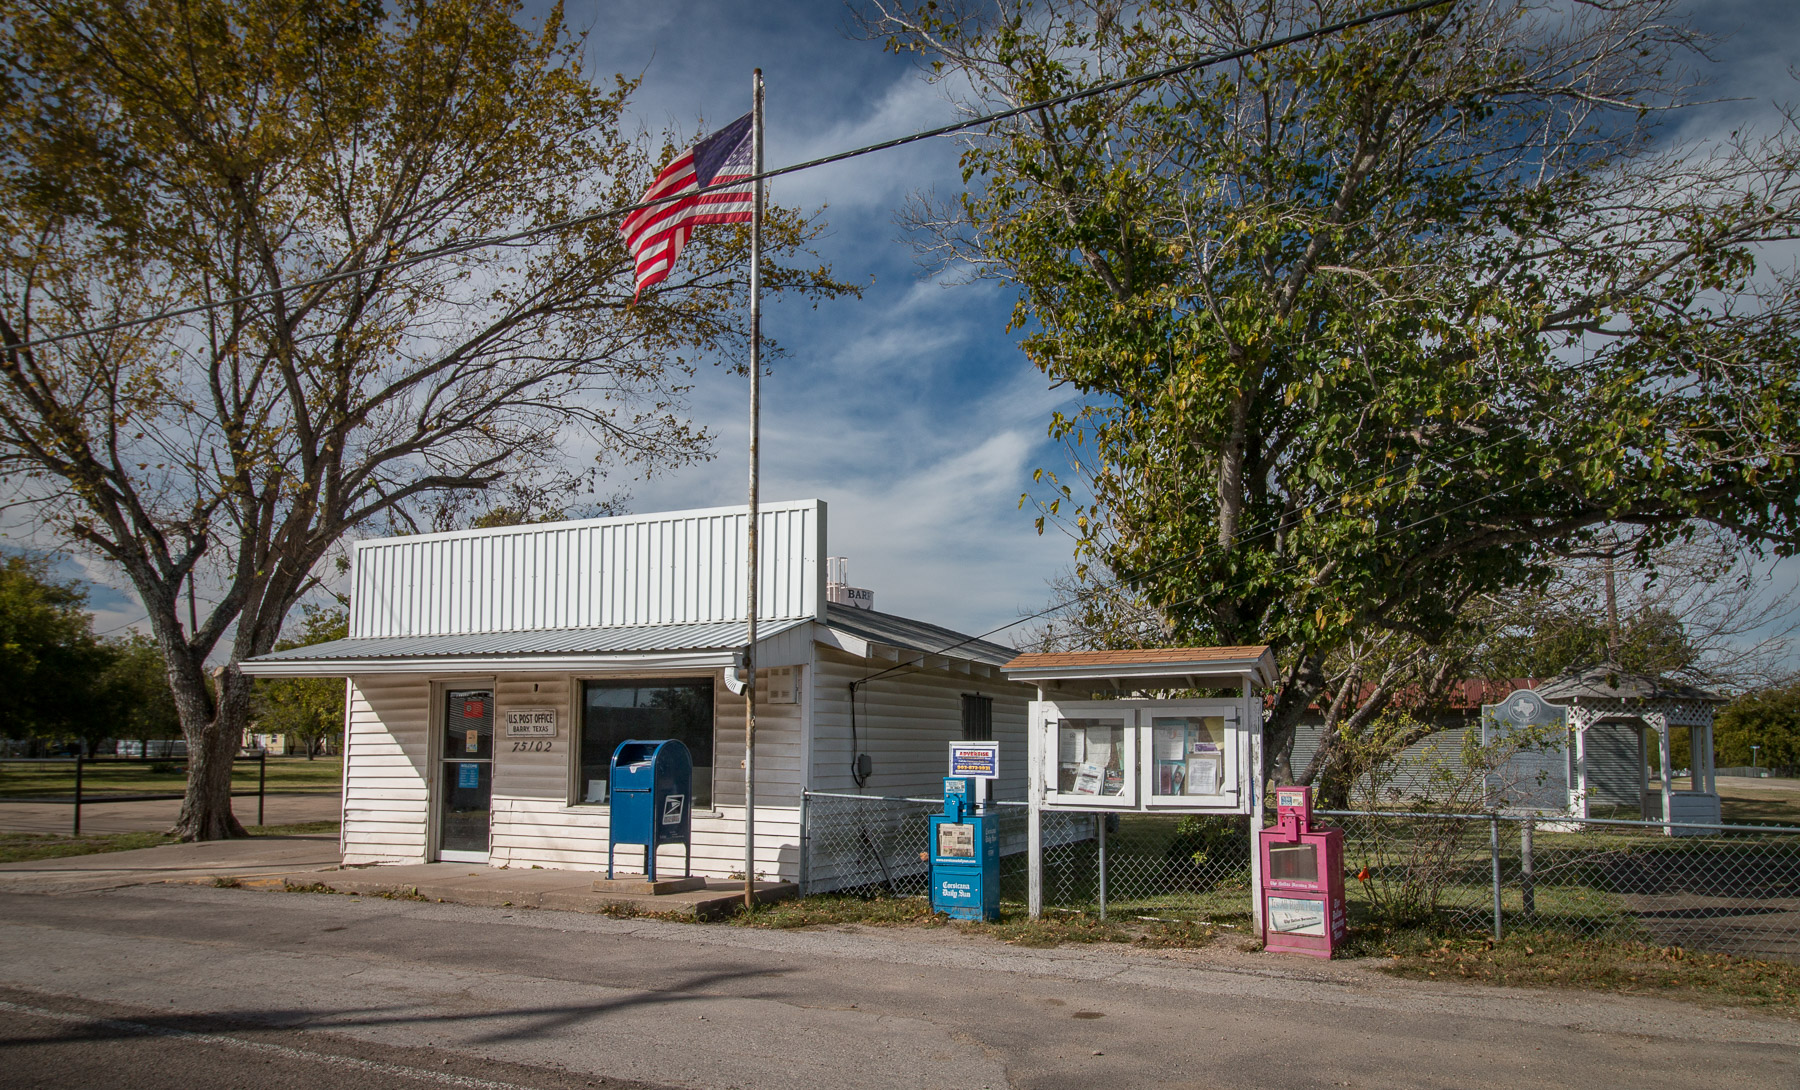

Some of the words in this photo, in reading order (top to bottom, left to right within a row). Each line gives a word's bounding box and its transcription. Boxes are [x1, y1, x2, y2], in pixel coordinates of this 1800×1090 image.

[509, 714, 518, 724] U.S.
[519, 714, 533, 724] POST
[535, 714, 552, 723] OFFICE
[512, 741, 552, 752] 75102
[943, 881, 970, 890] Corsicana
[942, 889, 957, 899] Daily
[959, 889, 971, 898] Sun
